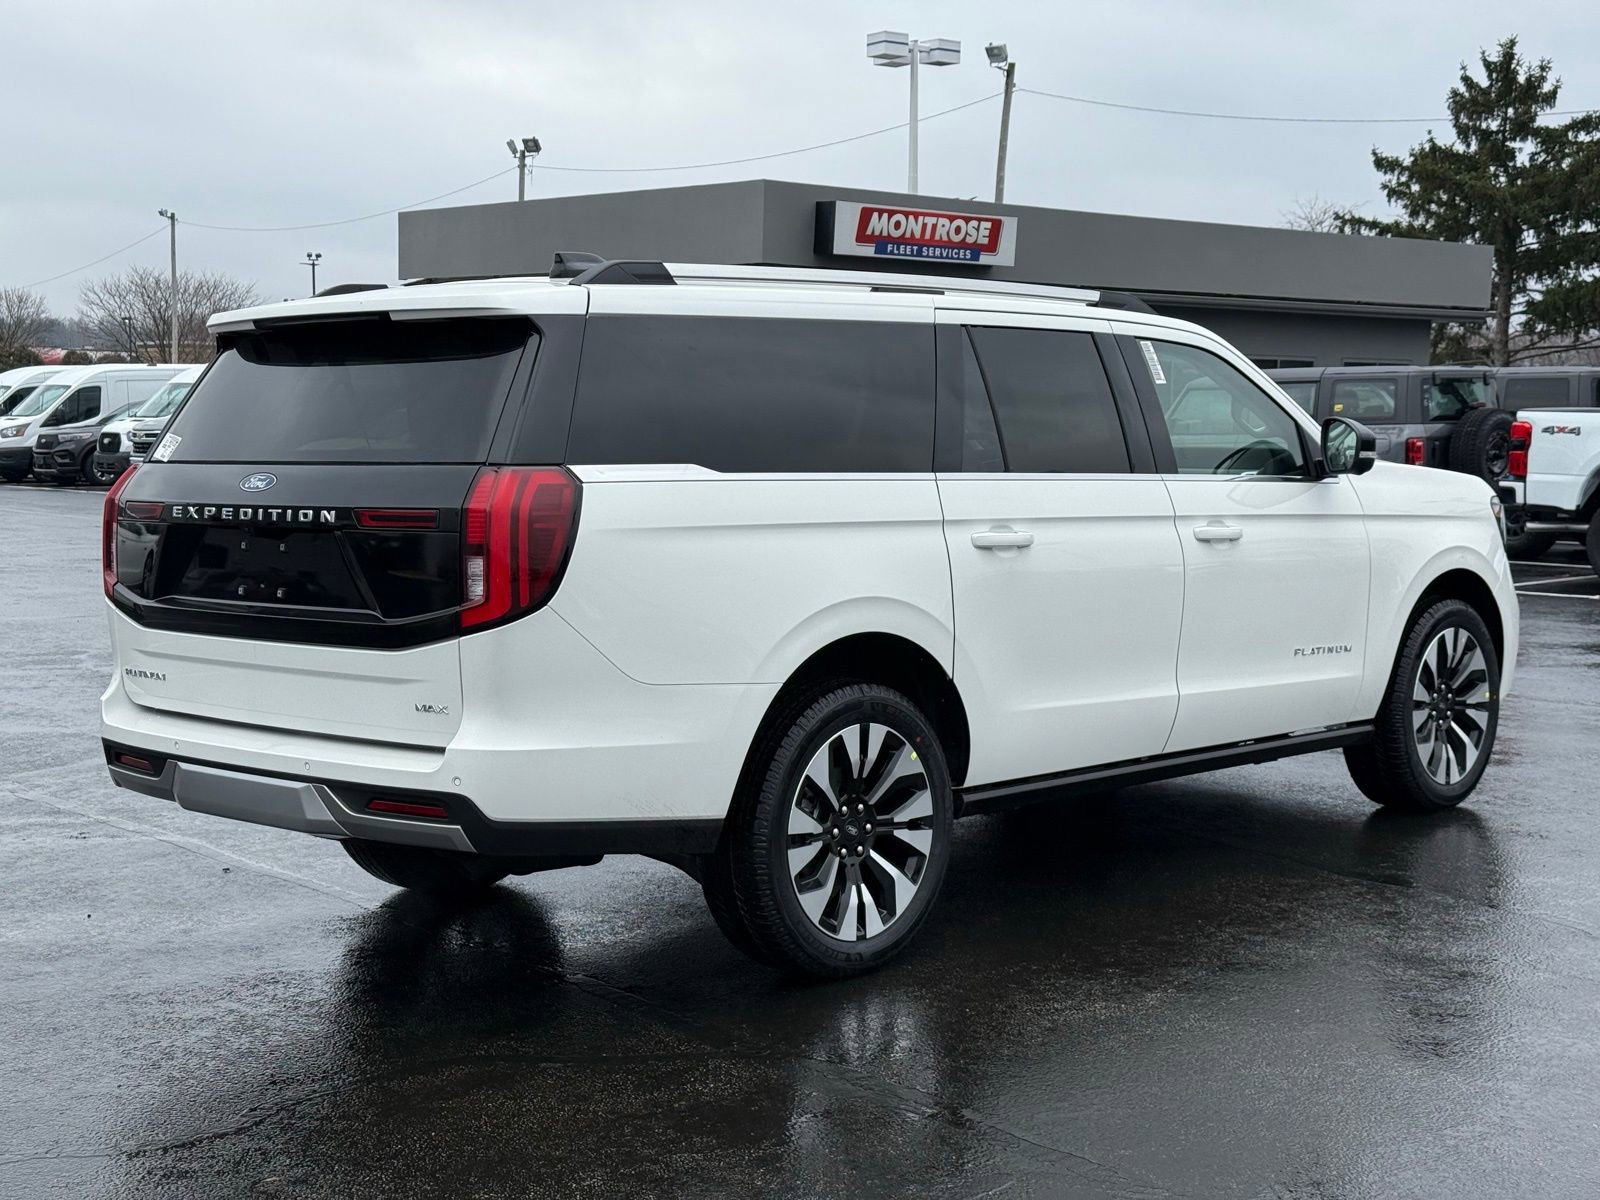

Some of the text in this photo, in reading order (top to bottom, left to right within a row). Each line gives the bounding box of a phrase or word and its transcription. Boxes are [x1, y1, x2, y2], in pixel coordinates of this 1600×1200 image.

[865, 211, 993, 245] MONTROSE
[887, 243, 971, 259] FLEET SERVICES
[243, 474, 273, 489] Ford
[171, 505, 336, 523] EXPEDITION
[1293, 644, 1353, 657] PLATINUM
[414, 703, 449, 715] MAX
